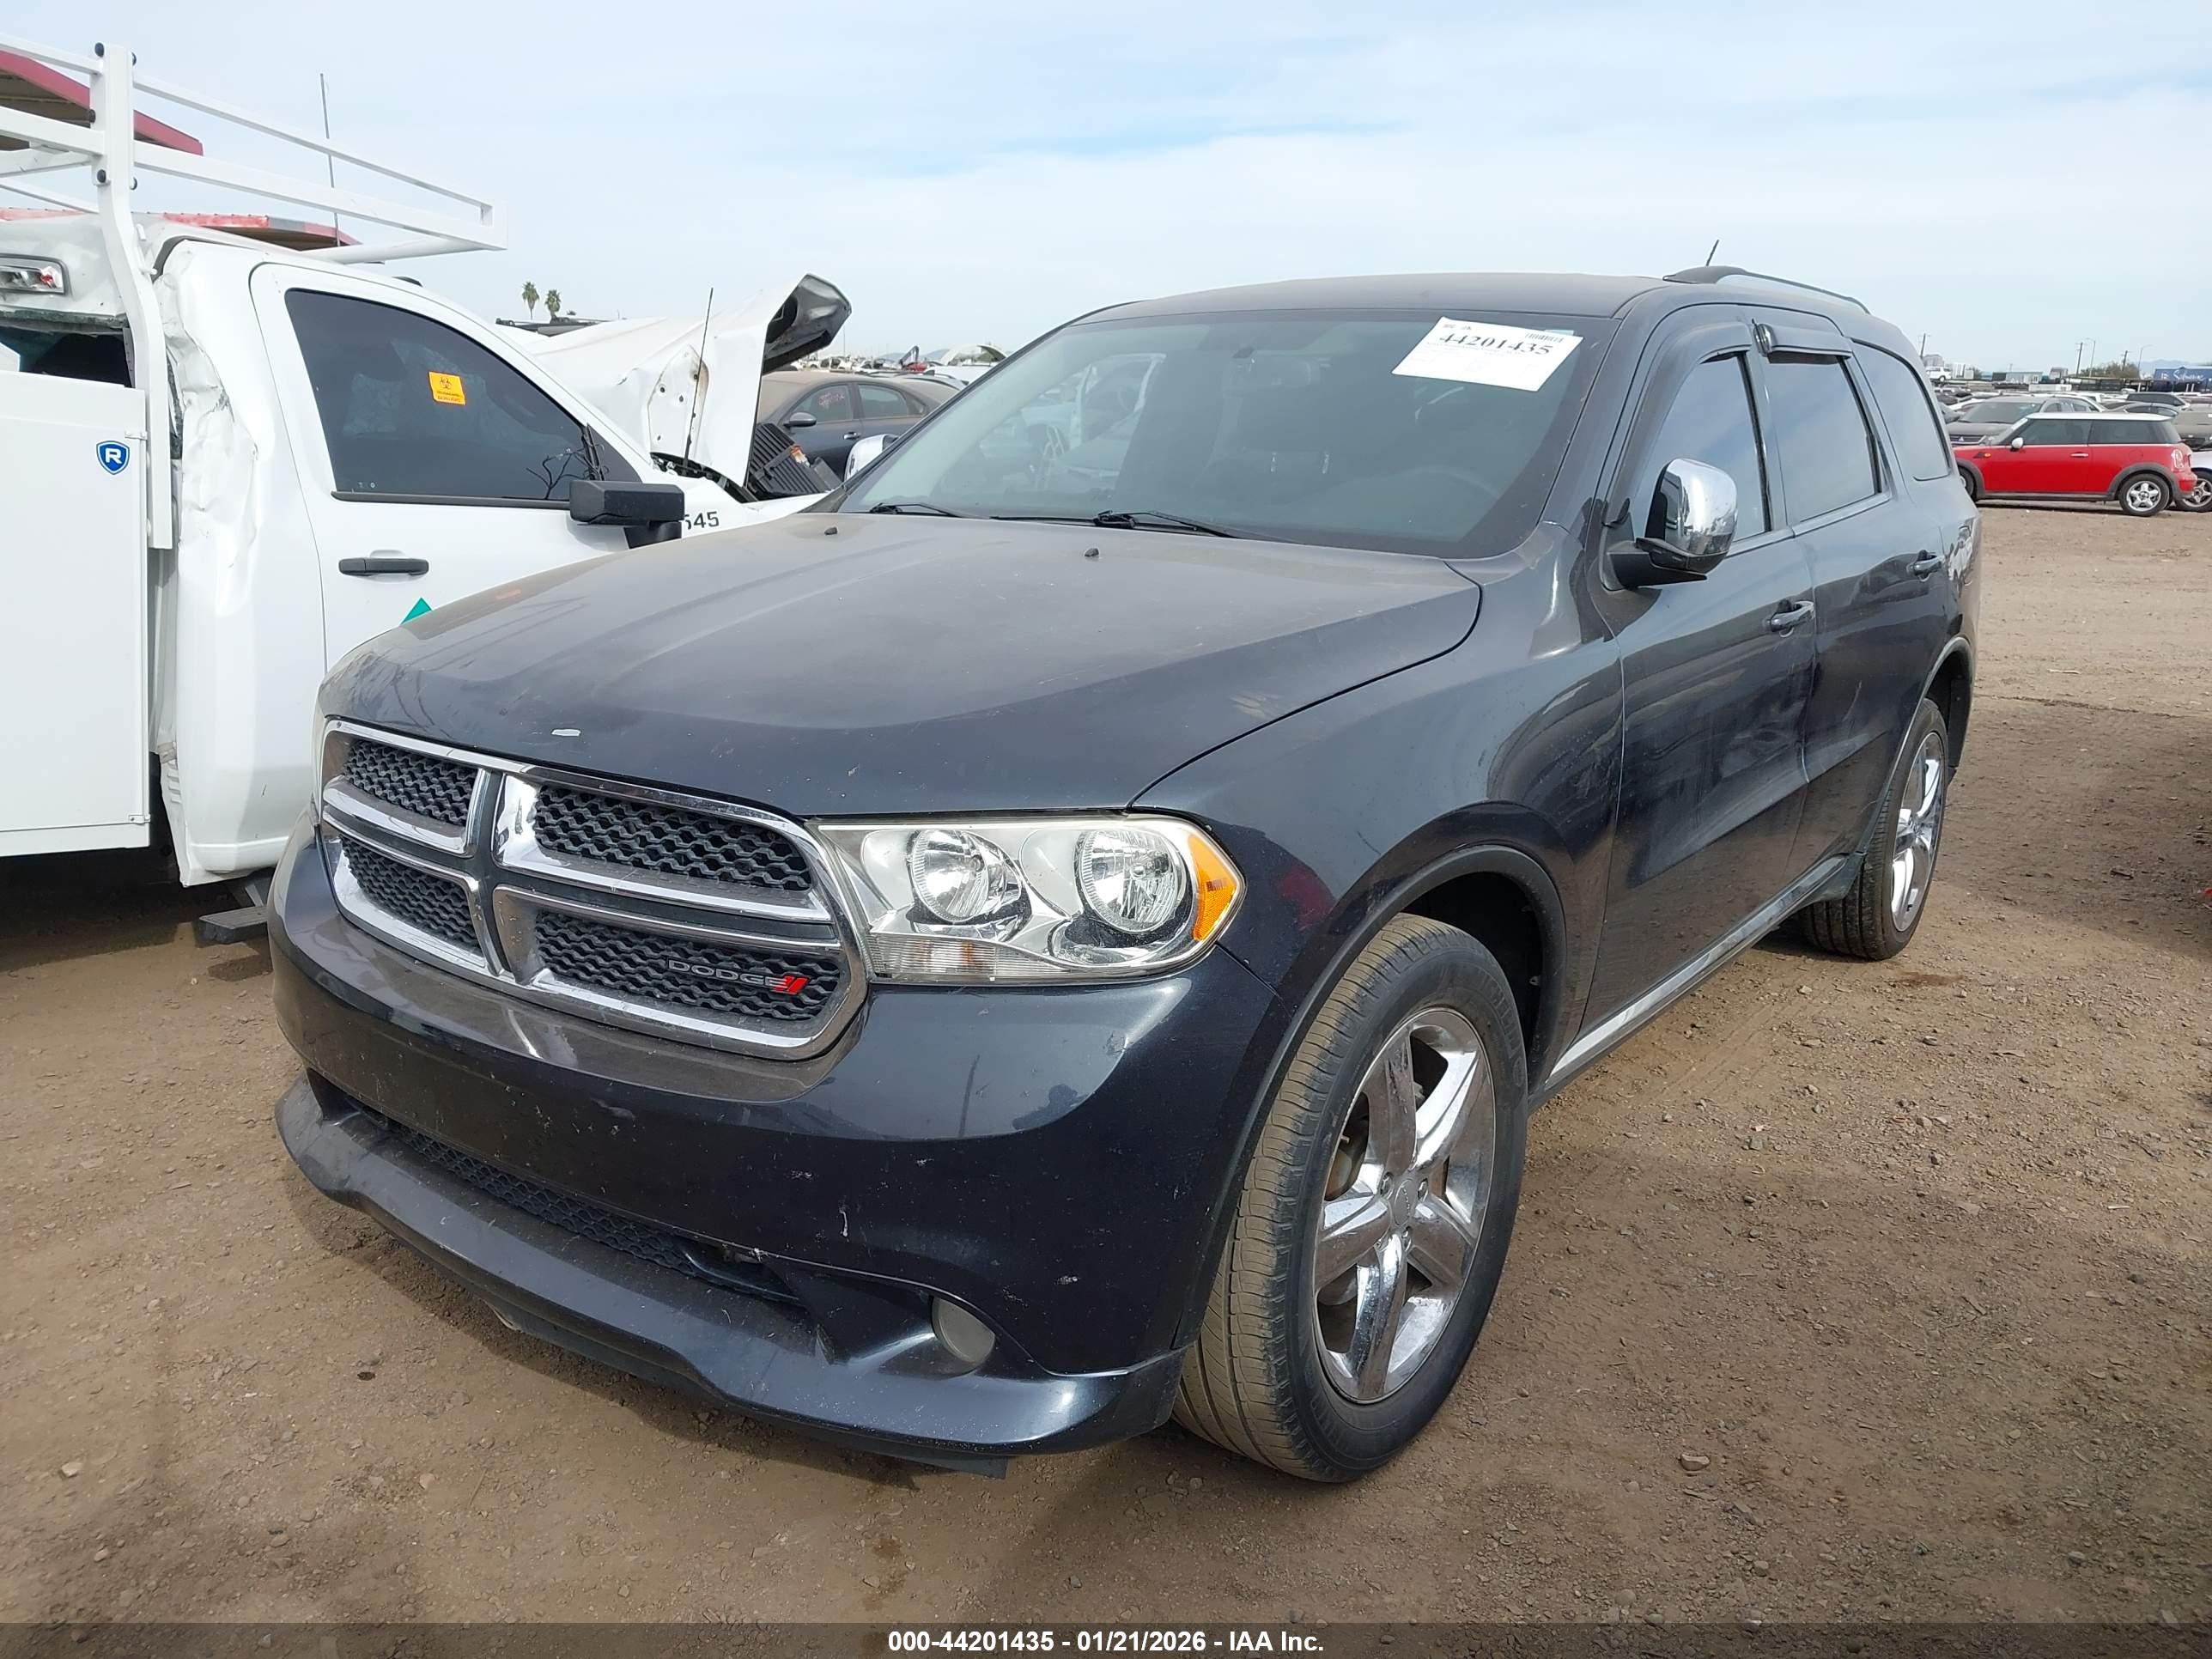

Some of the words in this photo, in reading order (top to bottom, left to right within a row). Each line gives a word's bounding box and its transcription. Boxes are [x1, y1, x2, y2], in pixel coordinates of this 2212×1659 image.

[1439, 332, 1553, 356] 44201435
[105, 447, 123, 465] R
[668, 959, 788, 989] DODGE
